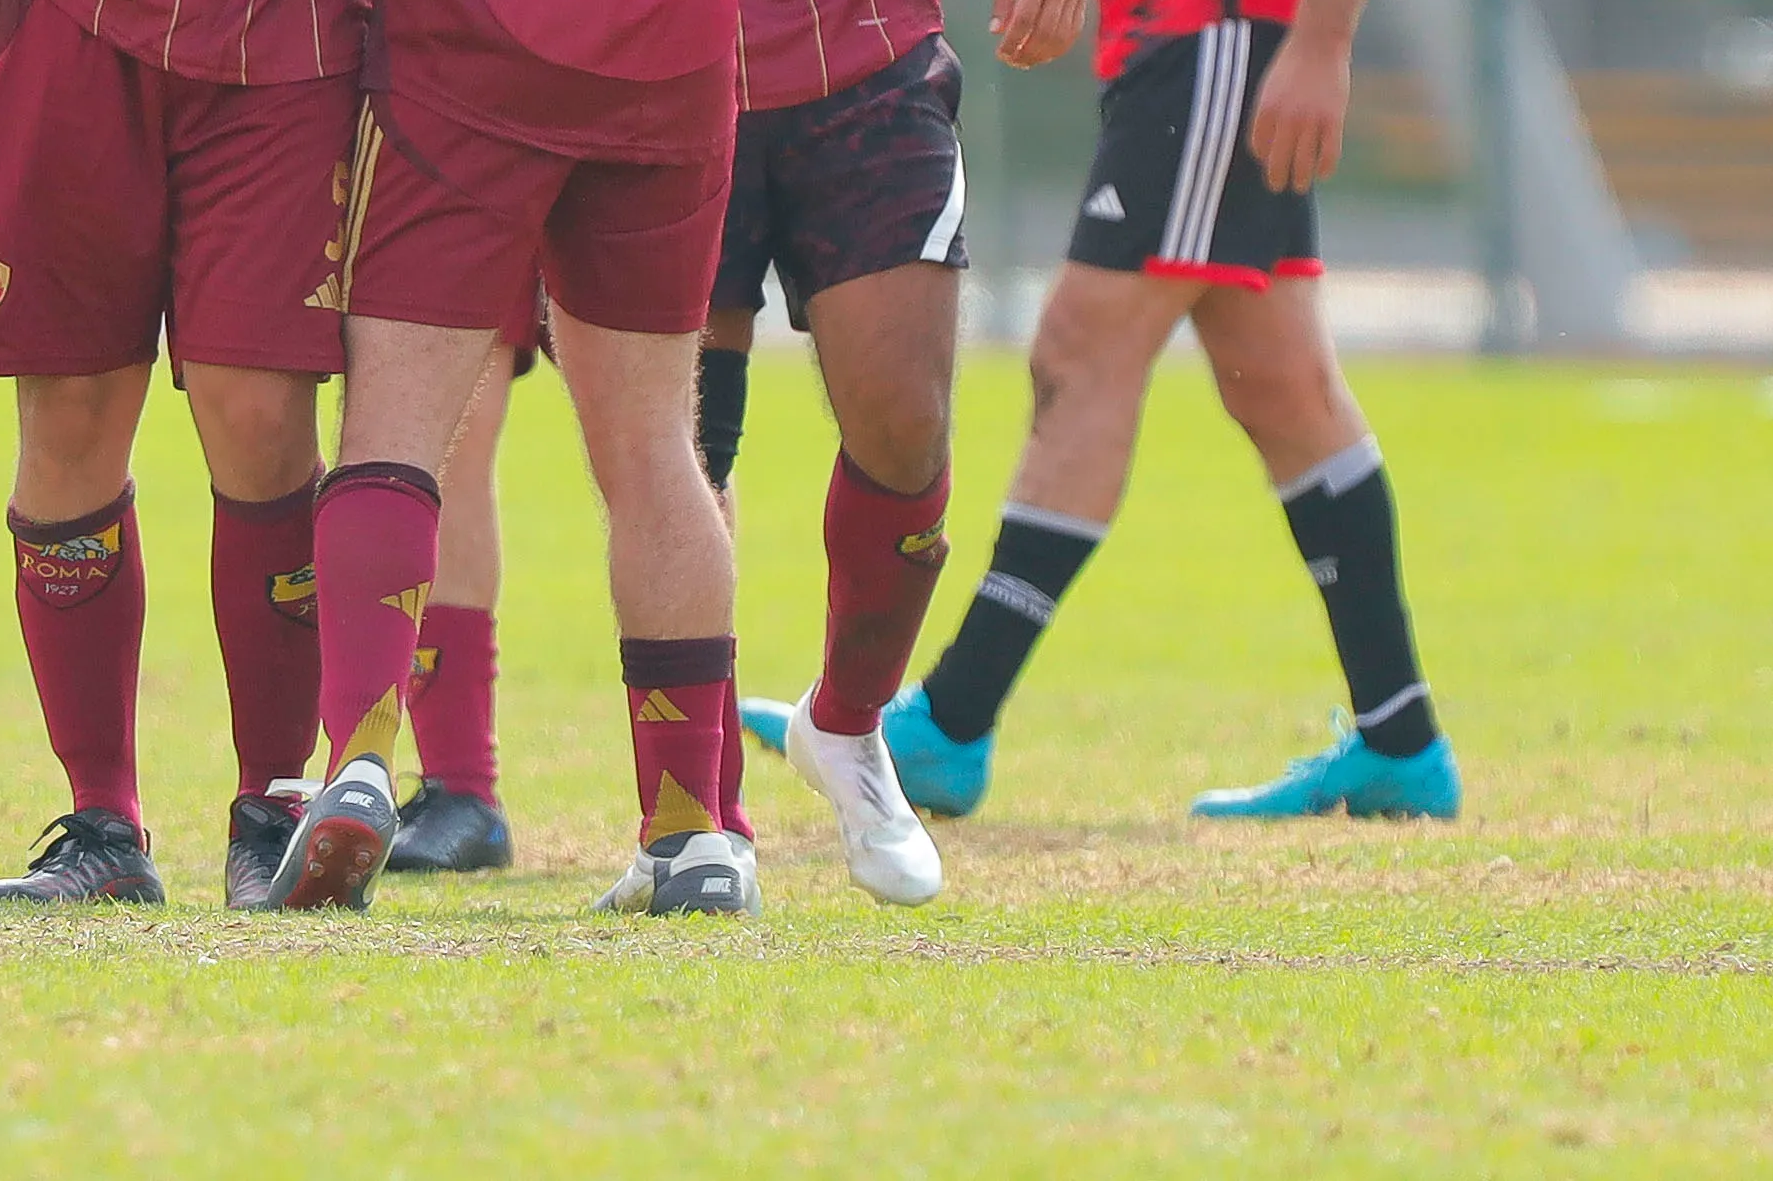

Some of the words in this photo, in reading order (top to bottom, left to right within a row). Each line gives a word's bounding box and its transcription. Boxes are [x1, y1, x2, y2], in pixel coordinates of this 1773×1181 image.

[21, 552, 108, 579] ROMA
[45, 582, 79, 596] 1927
[339, 790, 375, 808] NIKE
[700, 877, 732, 894] NIKE
